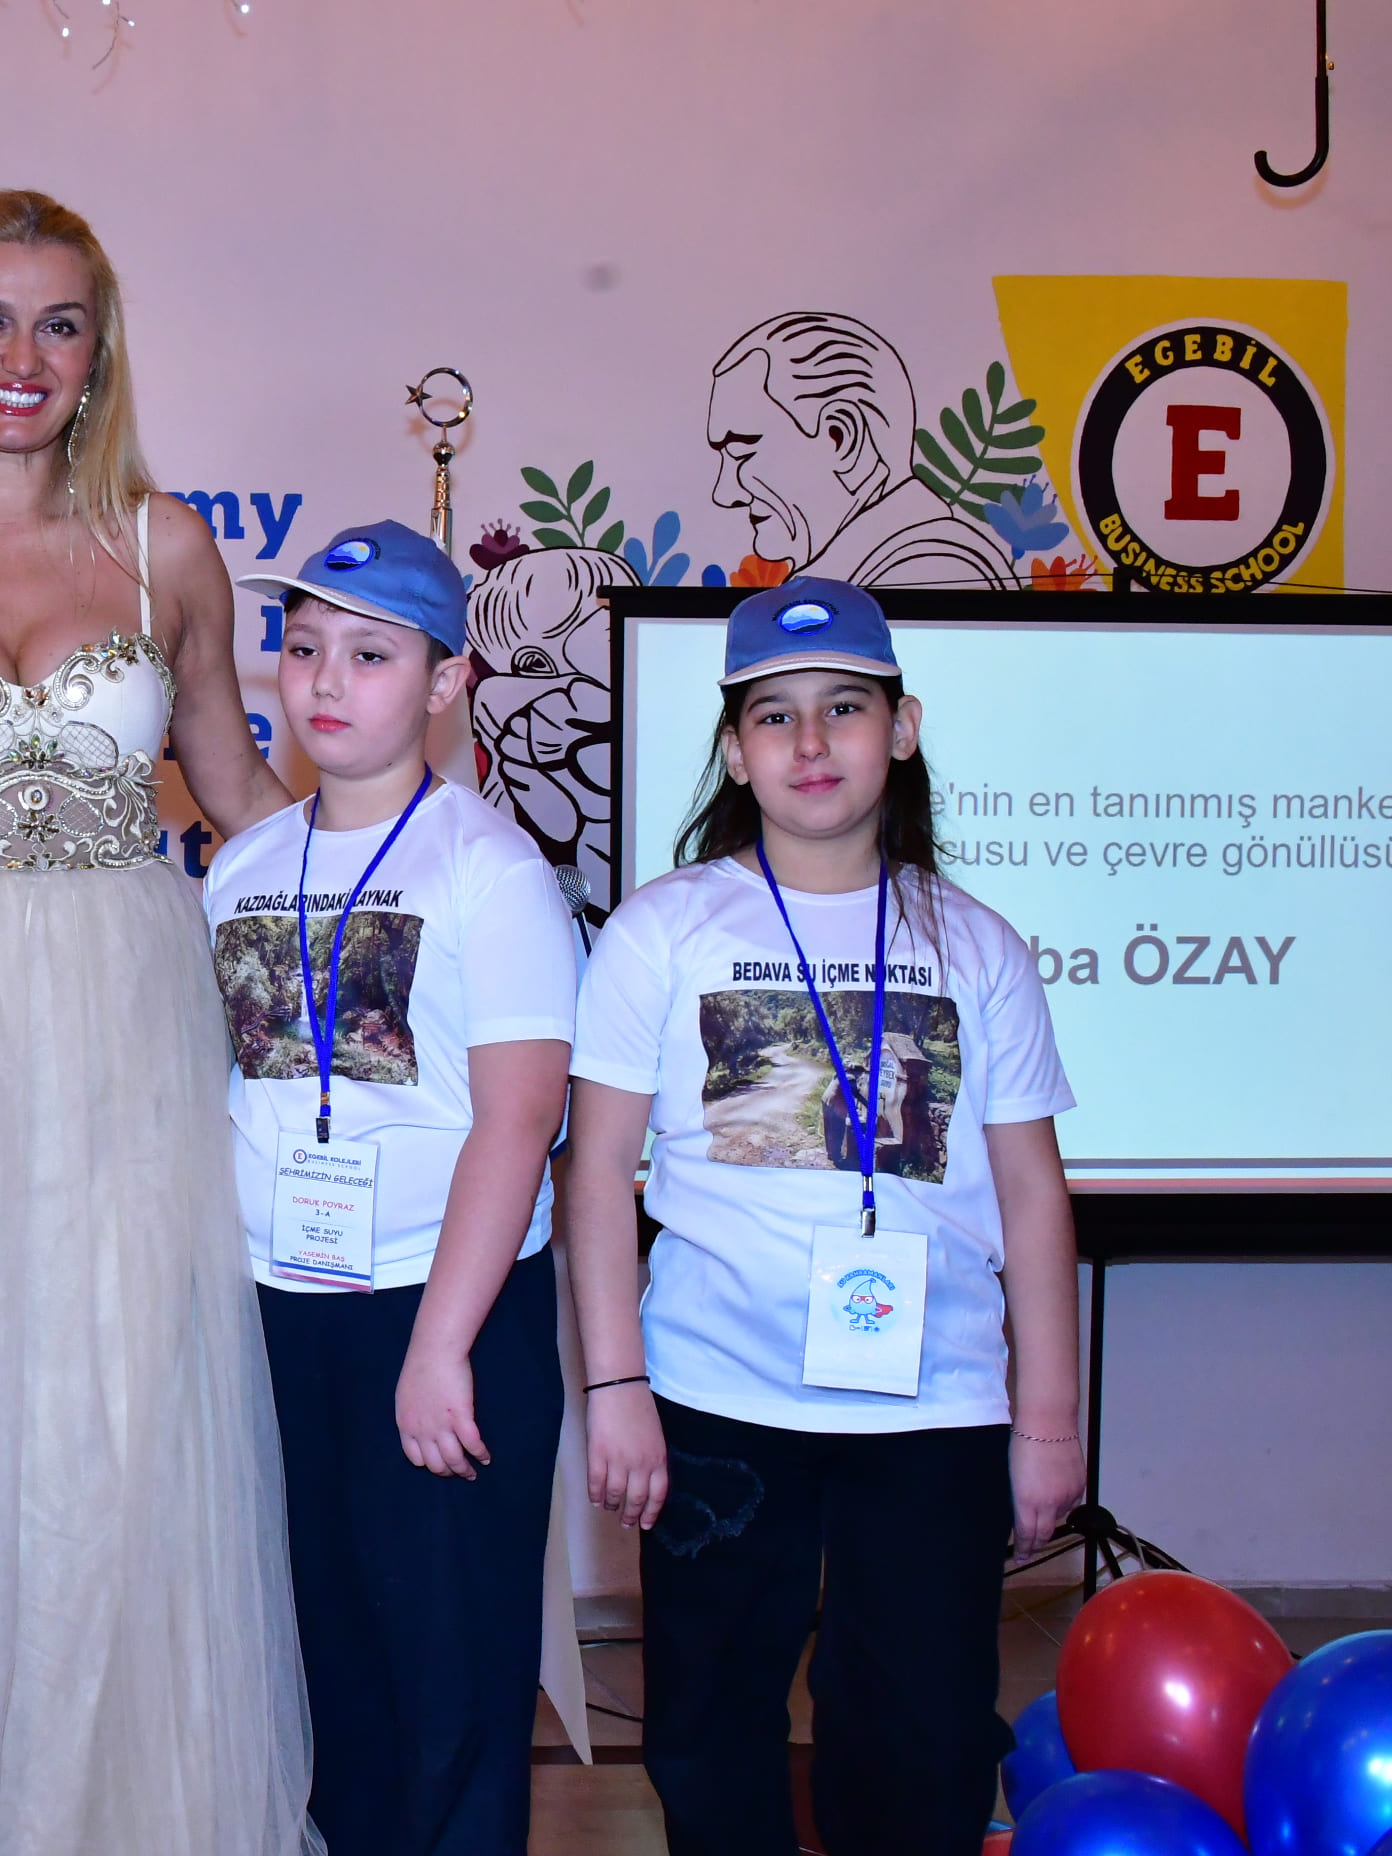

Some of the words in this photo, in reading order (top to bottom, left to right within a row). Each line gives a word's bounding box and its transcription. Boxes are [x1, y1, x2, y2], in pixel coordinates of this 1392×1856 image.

[1124, 333, 1279, 387] EGEBİL
[1164, 404, 1242, 522] E
[1099, 513, 1203, 593] BUSINESS
[1209, 521, 1305, 593] SCHOOL
[1028, 791, 1075, 817] en
[1090, 785, 1257, 829] tanınmış
[1044, 840, 1089, 867] ve
[1102, 840, 1208, 876] çevre
[732, 961, 793, 983] BEDAVA
[822, 958, 861, 989] İÇME
[865, 962, 933, 988] NKTASI
[1123, 922, 1297, 986] ÖZAY
[292, 1196, 320, 1207] DORUK
[322, 1200, 356, 1212] POYRAZ
[323, 1228, 344, 1237] SUYU
[289, 1255, 311, 1265] PROJE
